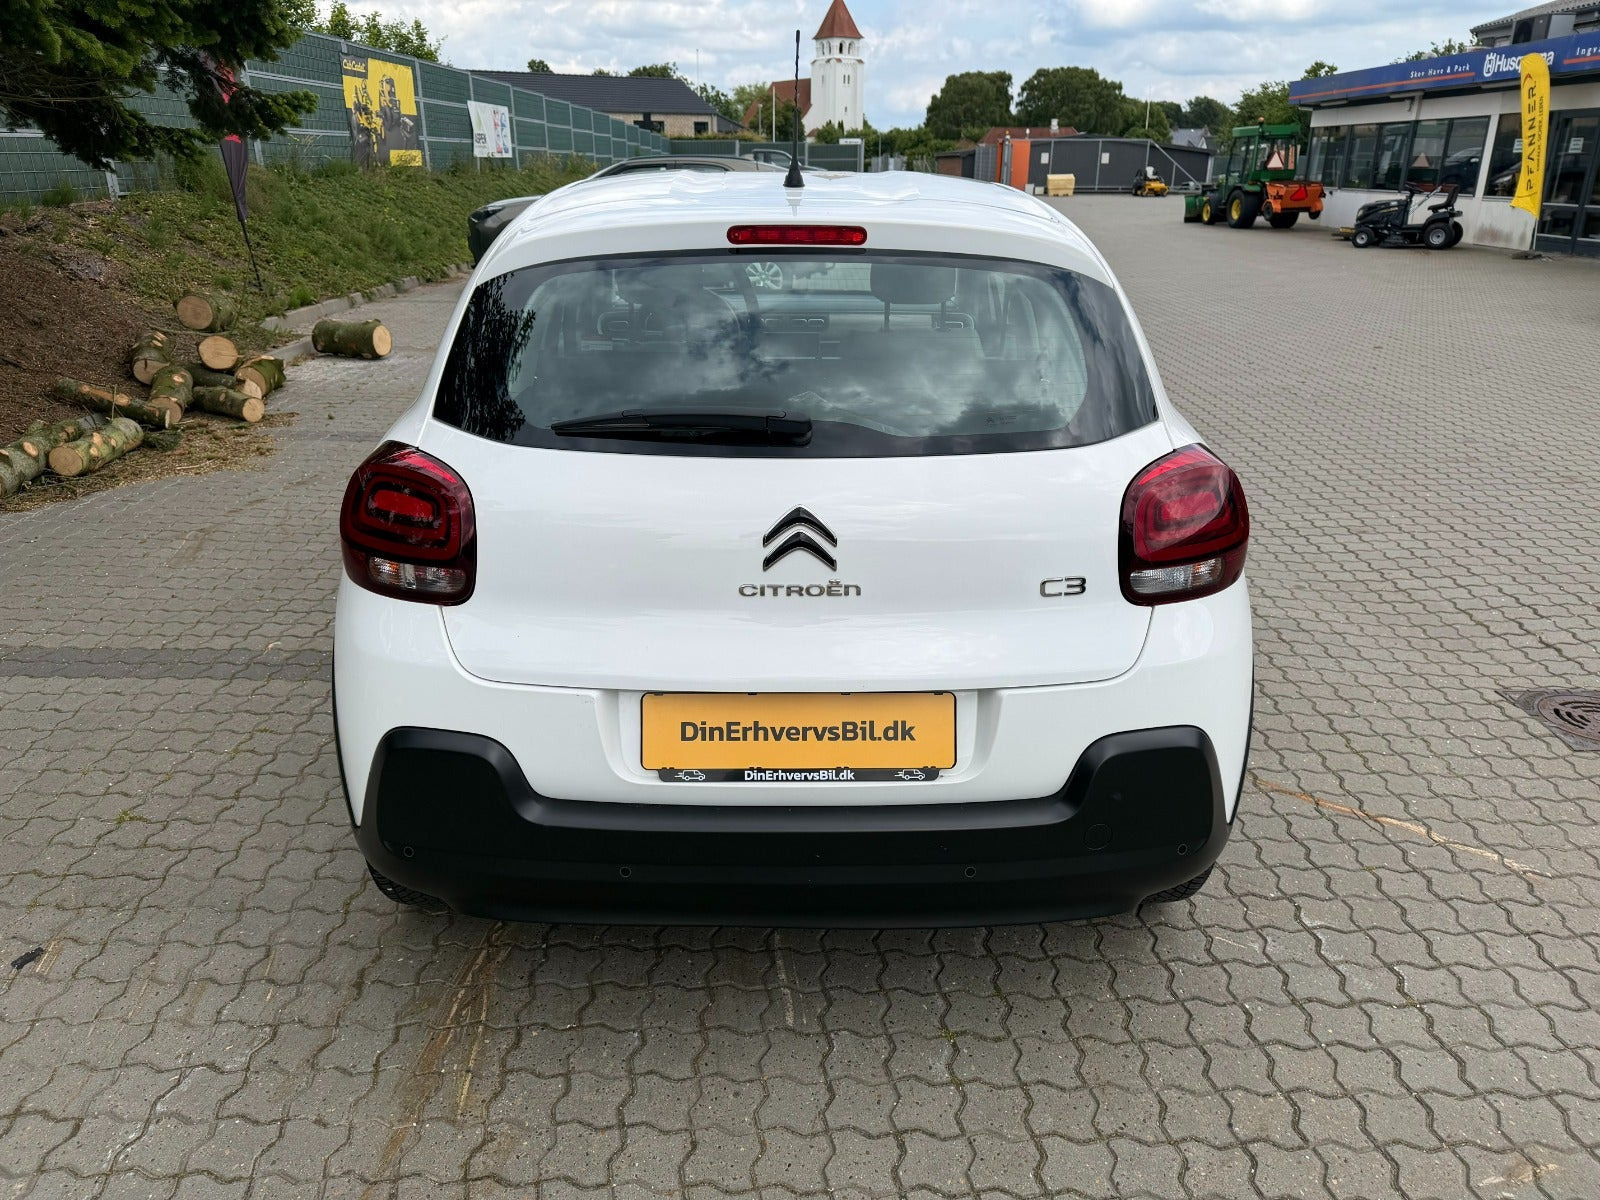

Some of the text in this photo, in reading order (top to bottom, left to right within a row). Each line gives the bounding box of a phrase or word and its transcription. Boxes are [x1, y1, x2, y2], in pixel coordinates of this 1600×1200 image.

[1454, 63, 1470, 72] Park
[1526, 86, 1537, 191] PFANNER
[738, 579, 862, 597] CITROËN
[1040, 576, 1087, 598] C3
[680, 720, 916, 742] DinErhvervsBil.dk
[744, 769, 855, 781] DinErhvervsBil.dk
